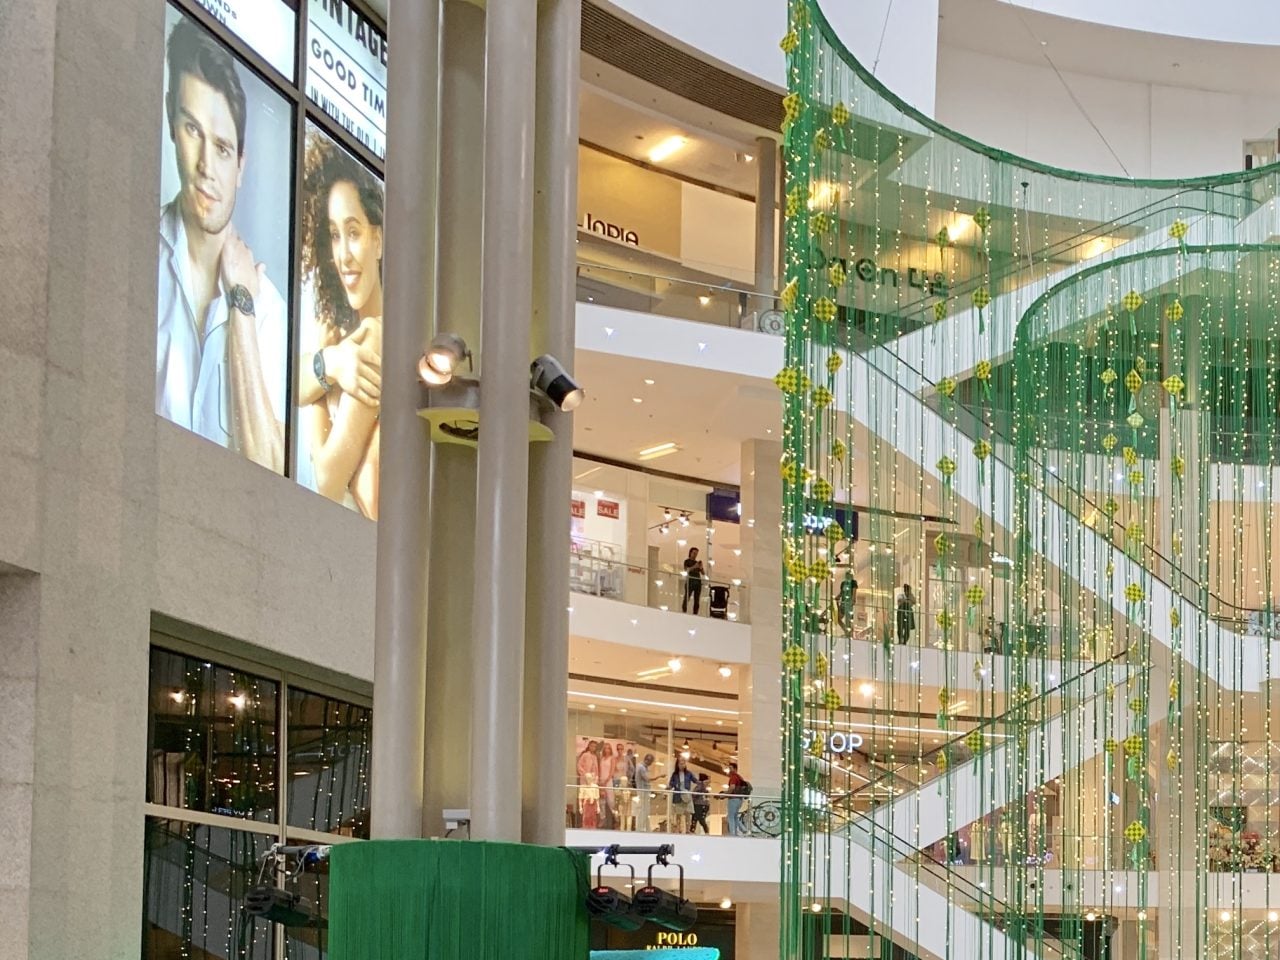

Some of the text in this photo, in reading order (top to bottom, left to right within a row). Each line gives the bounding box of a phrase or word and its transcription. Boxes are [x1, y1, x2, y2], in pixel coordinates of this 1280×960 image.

[311, 38, 386, 118] GOOD TIM
[599, 505, 618, 515] SALE
[657, 931, 698, 946] POLO
